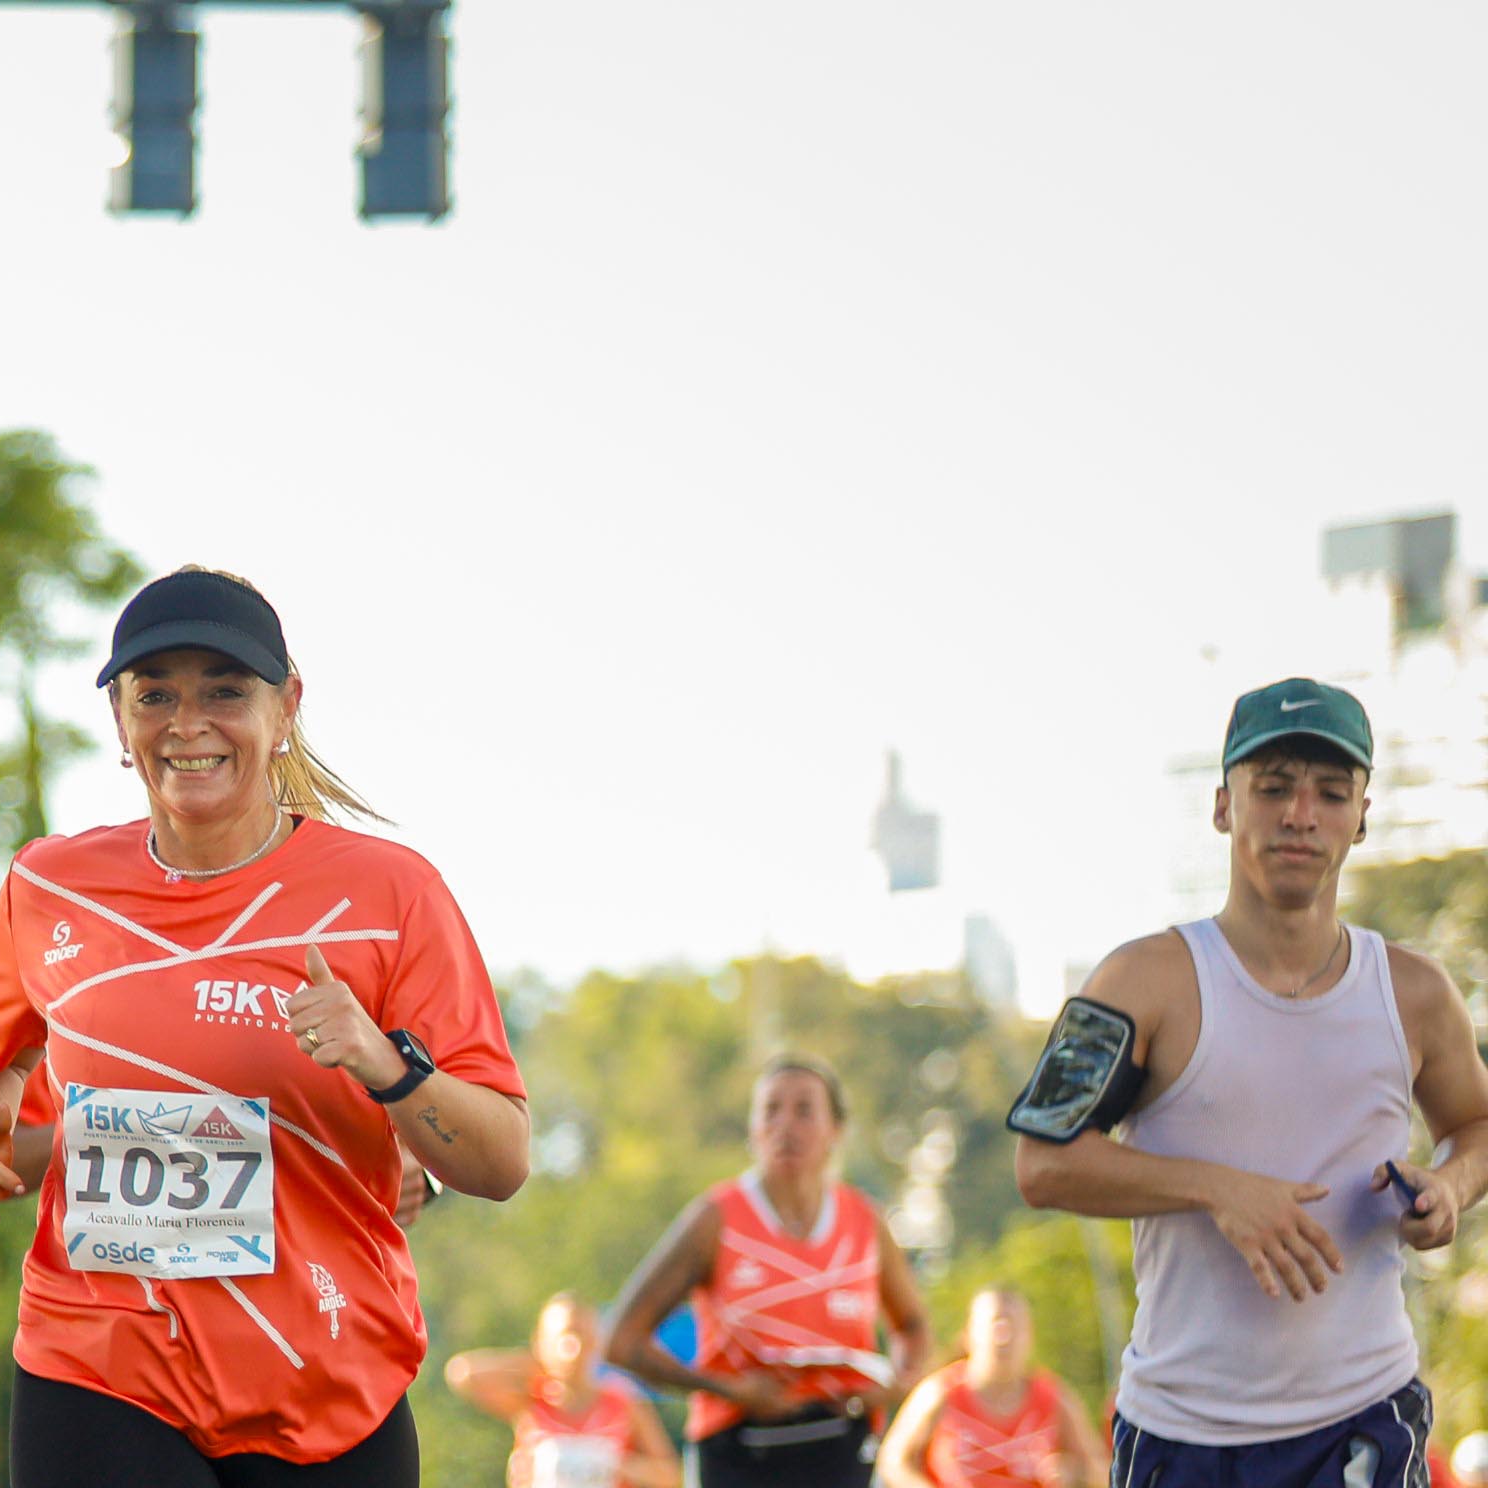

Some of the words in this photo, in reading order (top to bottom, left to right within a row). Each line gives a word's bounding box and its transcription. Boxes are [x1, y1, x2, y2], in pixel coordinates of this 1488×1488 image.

[193, 979, 267, 1017] 15K
[194, 1013, 264, 1028] PUERTO
[82, 1102, 135, 1134] 15K
[202, 1121, 233, 1136] 15K
[76, 1145, 263, 1211] 1037
[85, 1211, 142, 1227] Accavallo
[145, 1214, 182, 1229] Maria
[186, 1216, 246, 1228] Florencia
[92, 1241, 156, 1265] osde
[318, 1293, 347, 1313] ARDEC
